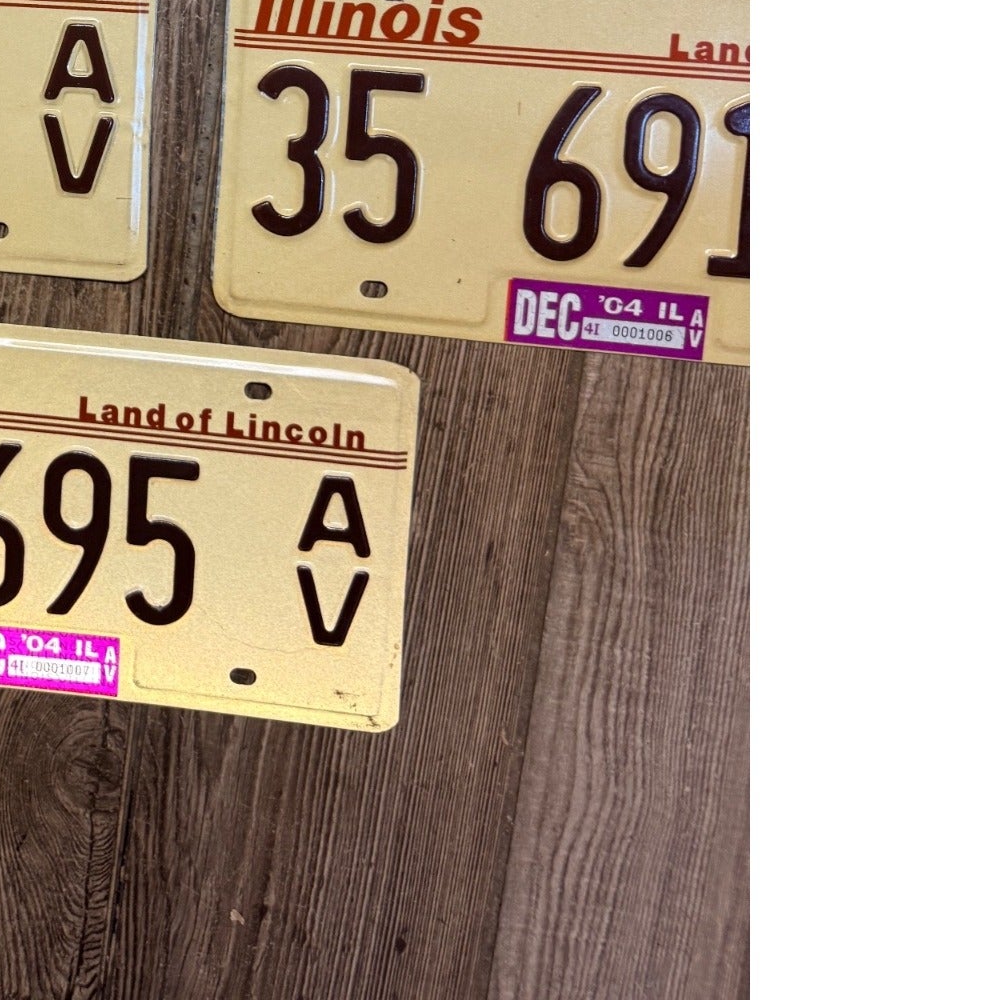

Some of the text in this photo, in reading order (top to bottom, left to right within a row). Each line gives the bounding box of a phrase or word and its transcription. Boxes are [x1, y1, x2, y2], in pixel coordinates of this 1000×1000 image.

[252, 65, 425, 244] 35
[513, 289, 582, 341] DEC
[658, 302, 684, 321] IL
[612, 325, 674, 342] 0001006
[79, 396, 365, 450] Land of Lincoln
[75, 639, 99, 658] IL
